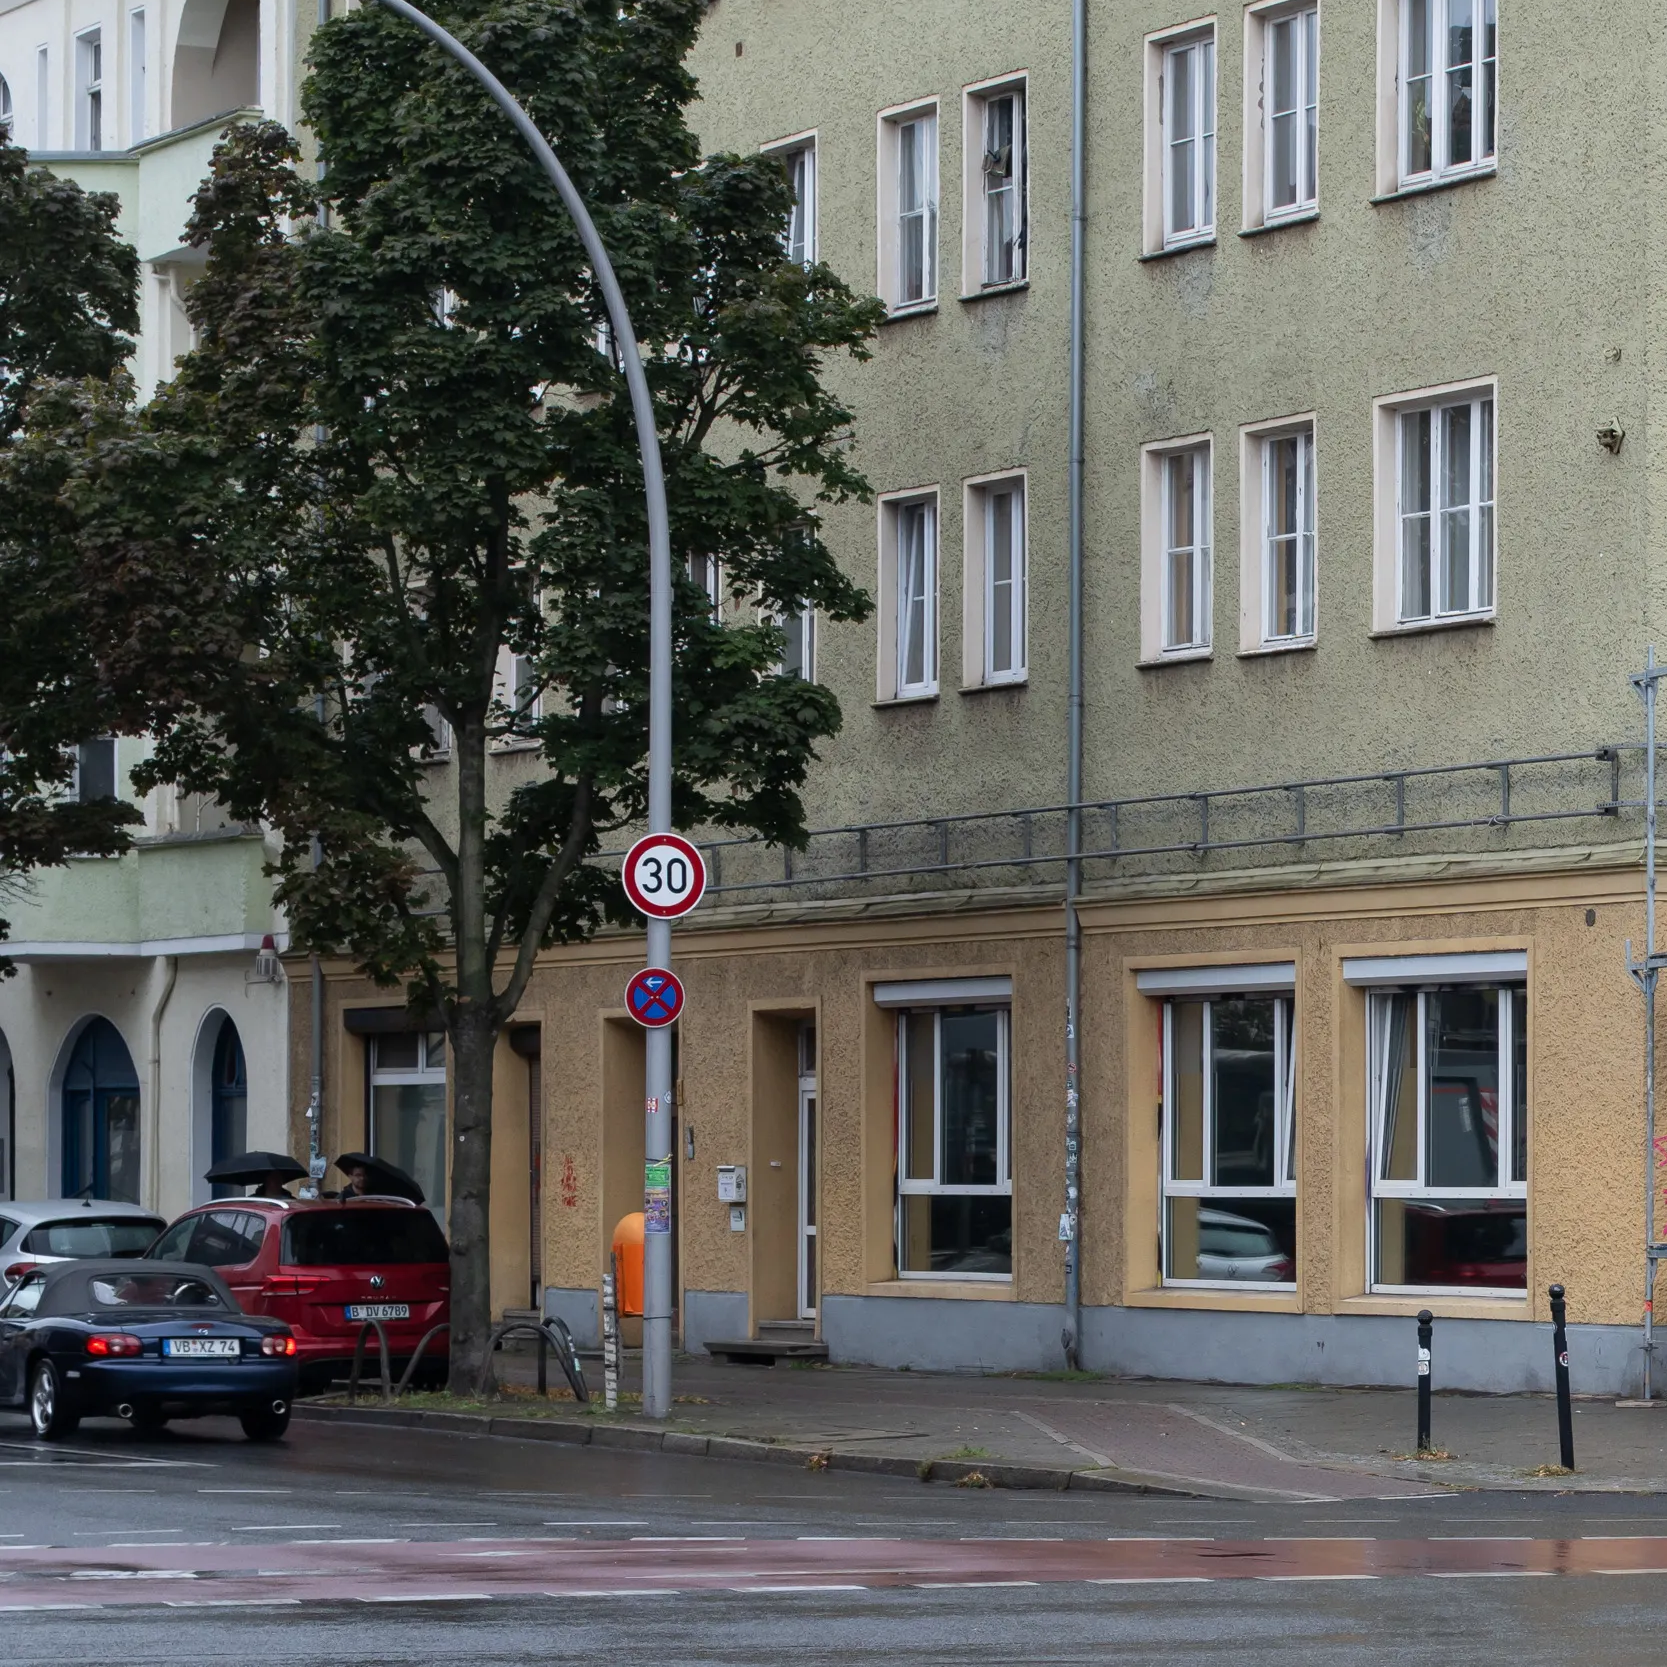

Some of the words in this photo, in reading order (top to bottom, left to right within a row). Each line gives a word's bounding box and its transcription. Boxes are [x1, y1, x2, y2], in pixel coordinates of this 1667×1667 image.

[642, 857, 687, 894] 30
[352, 1306, 360, 1318] B
[365, 1306, 380, 1317] DV
[382, 1305, 408, 1317] 6789
[174, 1340, 191, 1353] VB
[199, 1340, 216, 1353] XZ
[219, 1340, 236, 1353] 74
